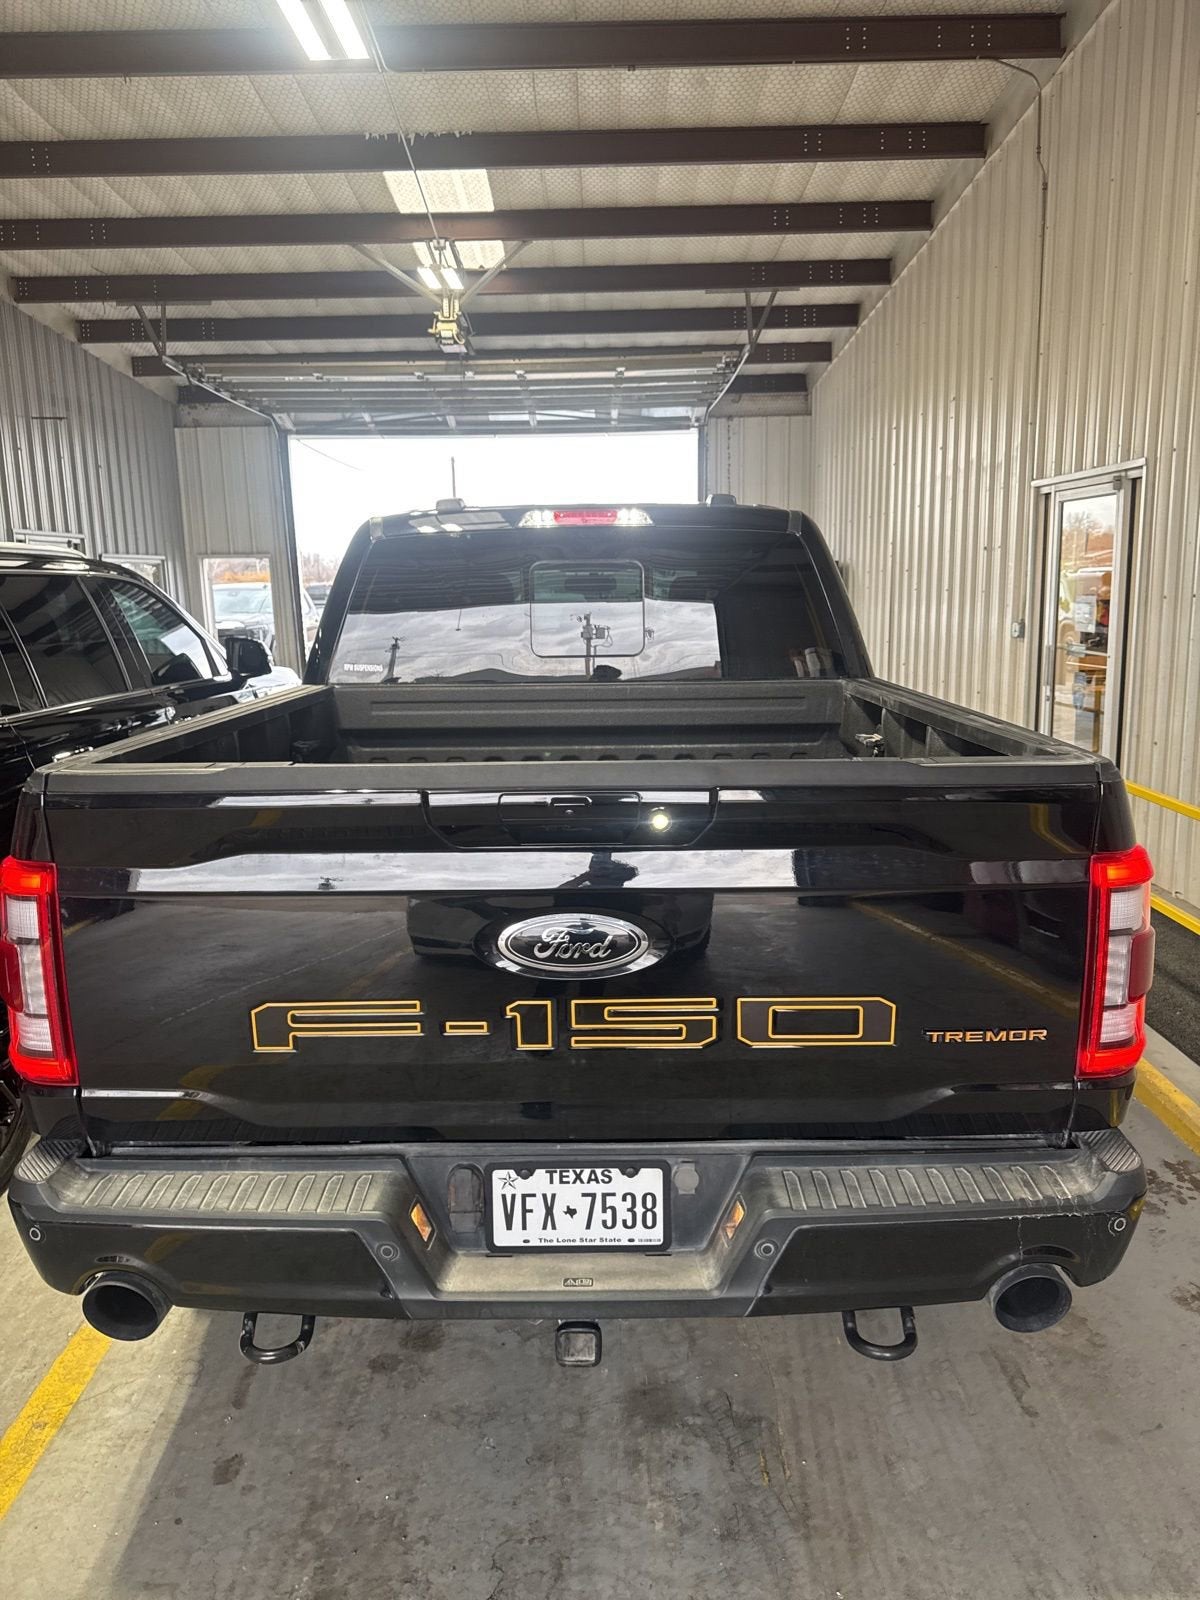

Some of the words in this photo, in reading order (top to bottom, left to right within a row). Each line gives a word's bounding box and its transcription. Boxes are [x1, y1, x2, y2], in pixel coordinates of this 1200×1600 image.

[533, 926, 614, 959] Ford
[250, 997, 898, 1053] F-150
[925, 1028, 1048, 1044] TREMOR
[545, 1168, 613, 1185] TEXAS
[500, 1192, 557, 1231] VFX
[580, 1191, 658, 1231] 7538
